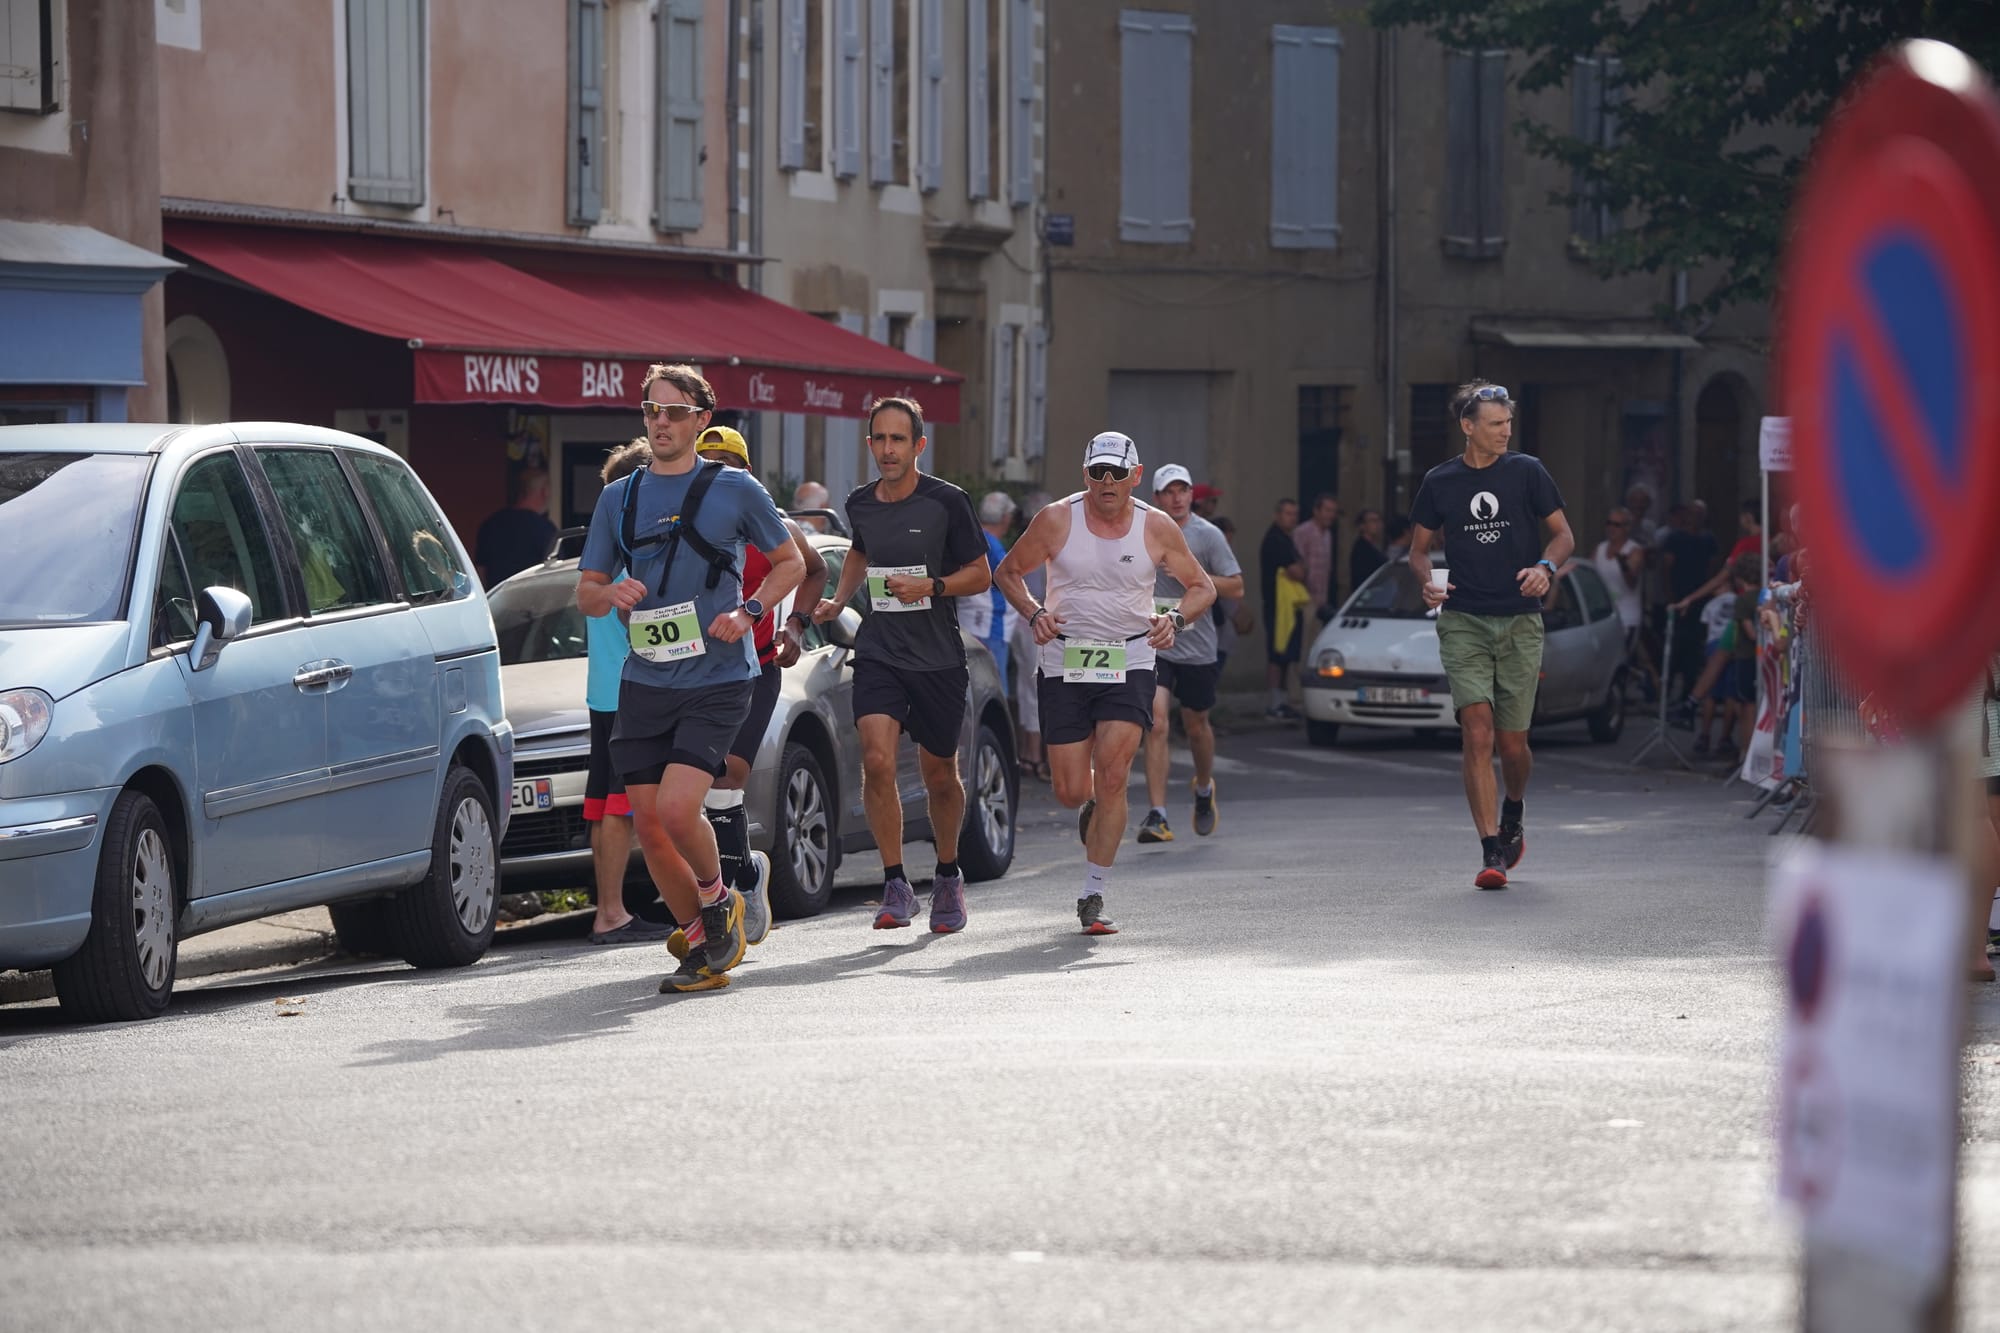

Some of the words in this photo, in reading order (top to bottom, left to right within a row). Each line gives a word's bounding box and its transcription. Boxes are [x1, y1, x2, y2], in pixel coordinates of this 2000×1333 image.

[464, 355, 540, 394] RYAN'S
[582, 361, 624, 397] BAR
[749, 372, 775, 403] Chez
[1464, 523, 1487, 531] PARIS
[1489, 520, 1510, 529] 2024
[645, 621, 680, 645] 30
[1080, 649, 1109, 668] 72
[539, 794, 550, 806] 48
